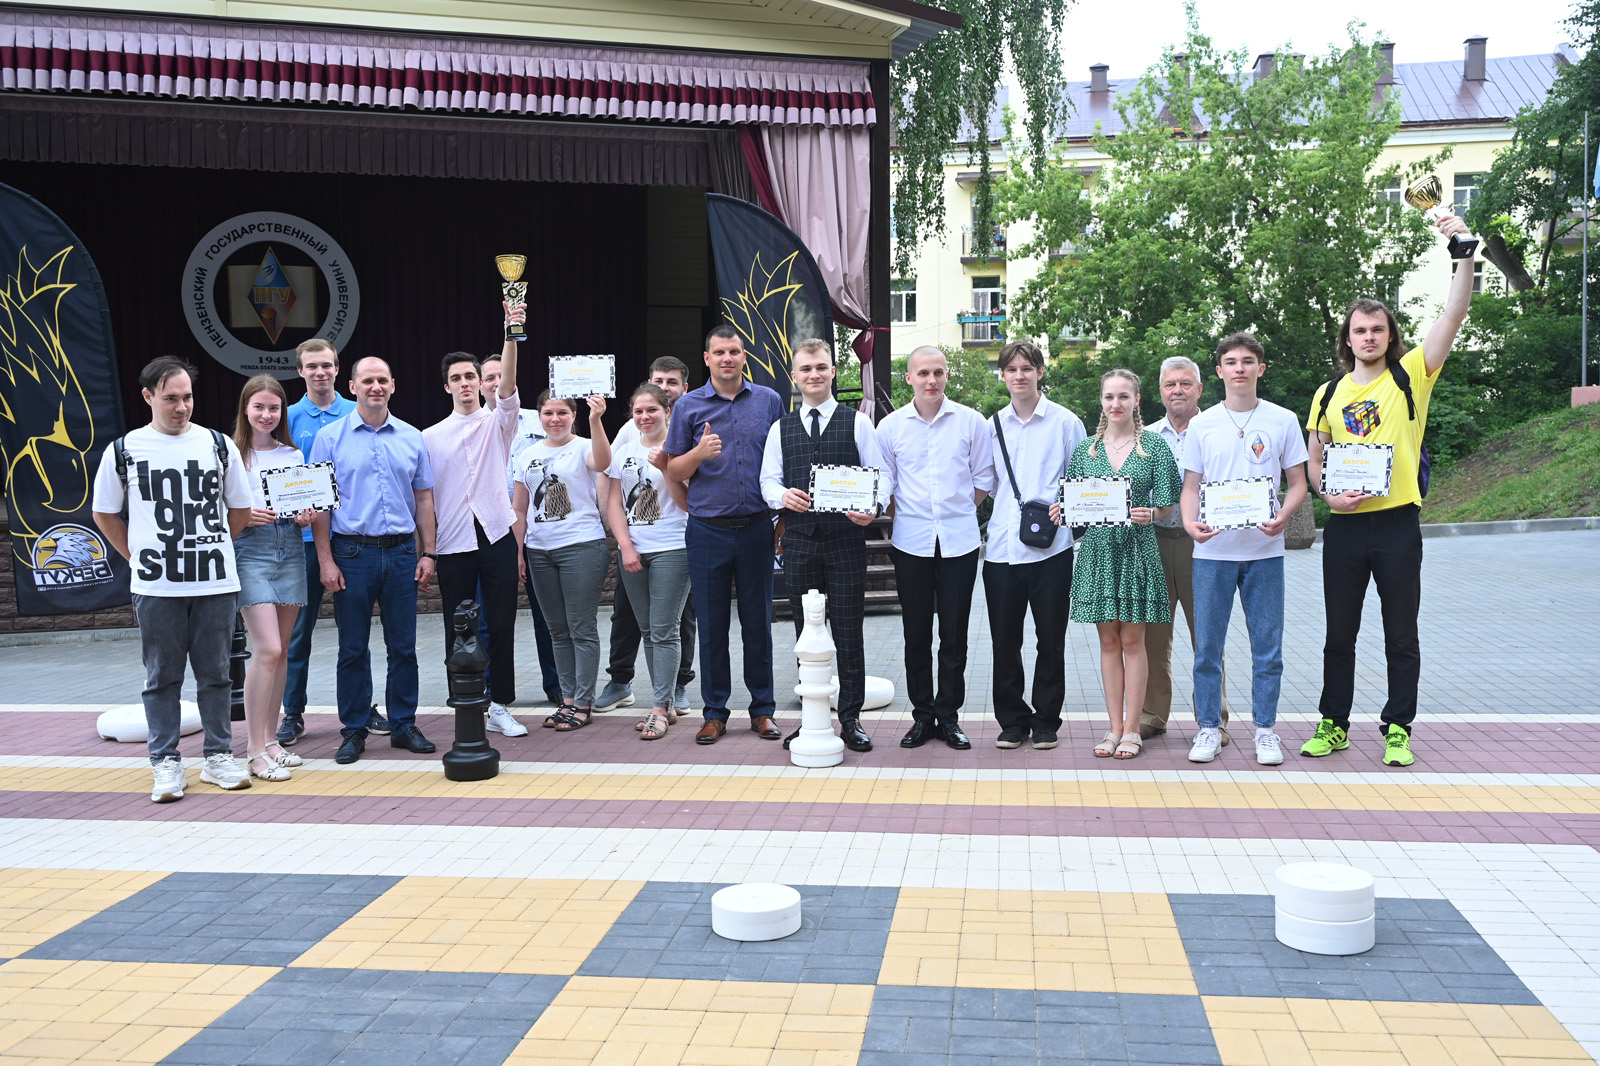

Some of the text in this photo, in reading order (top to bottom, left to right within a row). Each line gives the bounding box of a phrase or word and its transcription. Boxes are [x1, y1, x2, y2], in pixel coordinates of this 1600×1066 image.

[193, 222, 349, 349] ПЕНЗЕНСКИЙ ГОСУДАРСТВЕННЫЙ УНИВЕРСИТЕ
[253, 286, 291, 304] ПГУ
[258, 356, 289, 364] 1943
[136, 459, 220, 502] Inte
[284, 479, 313, 488] ДИПЛОМ
[154, 499, 221, 543] gre
[137, 538, 227, 582] stin
